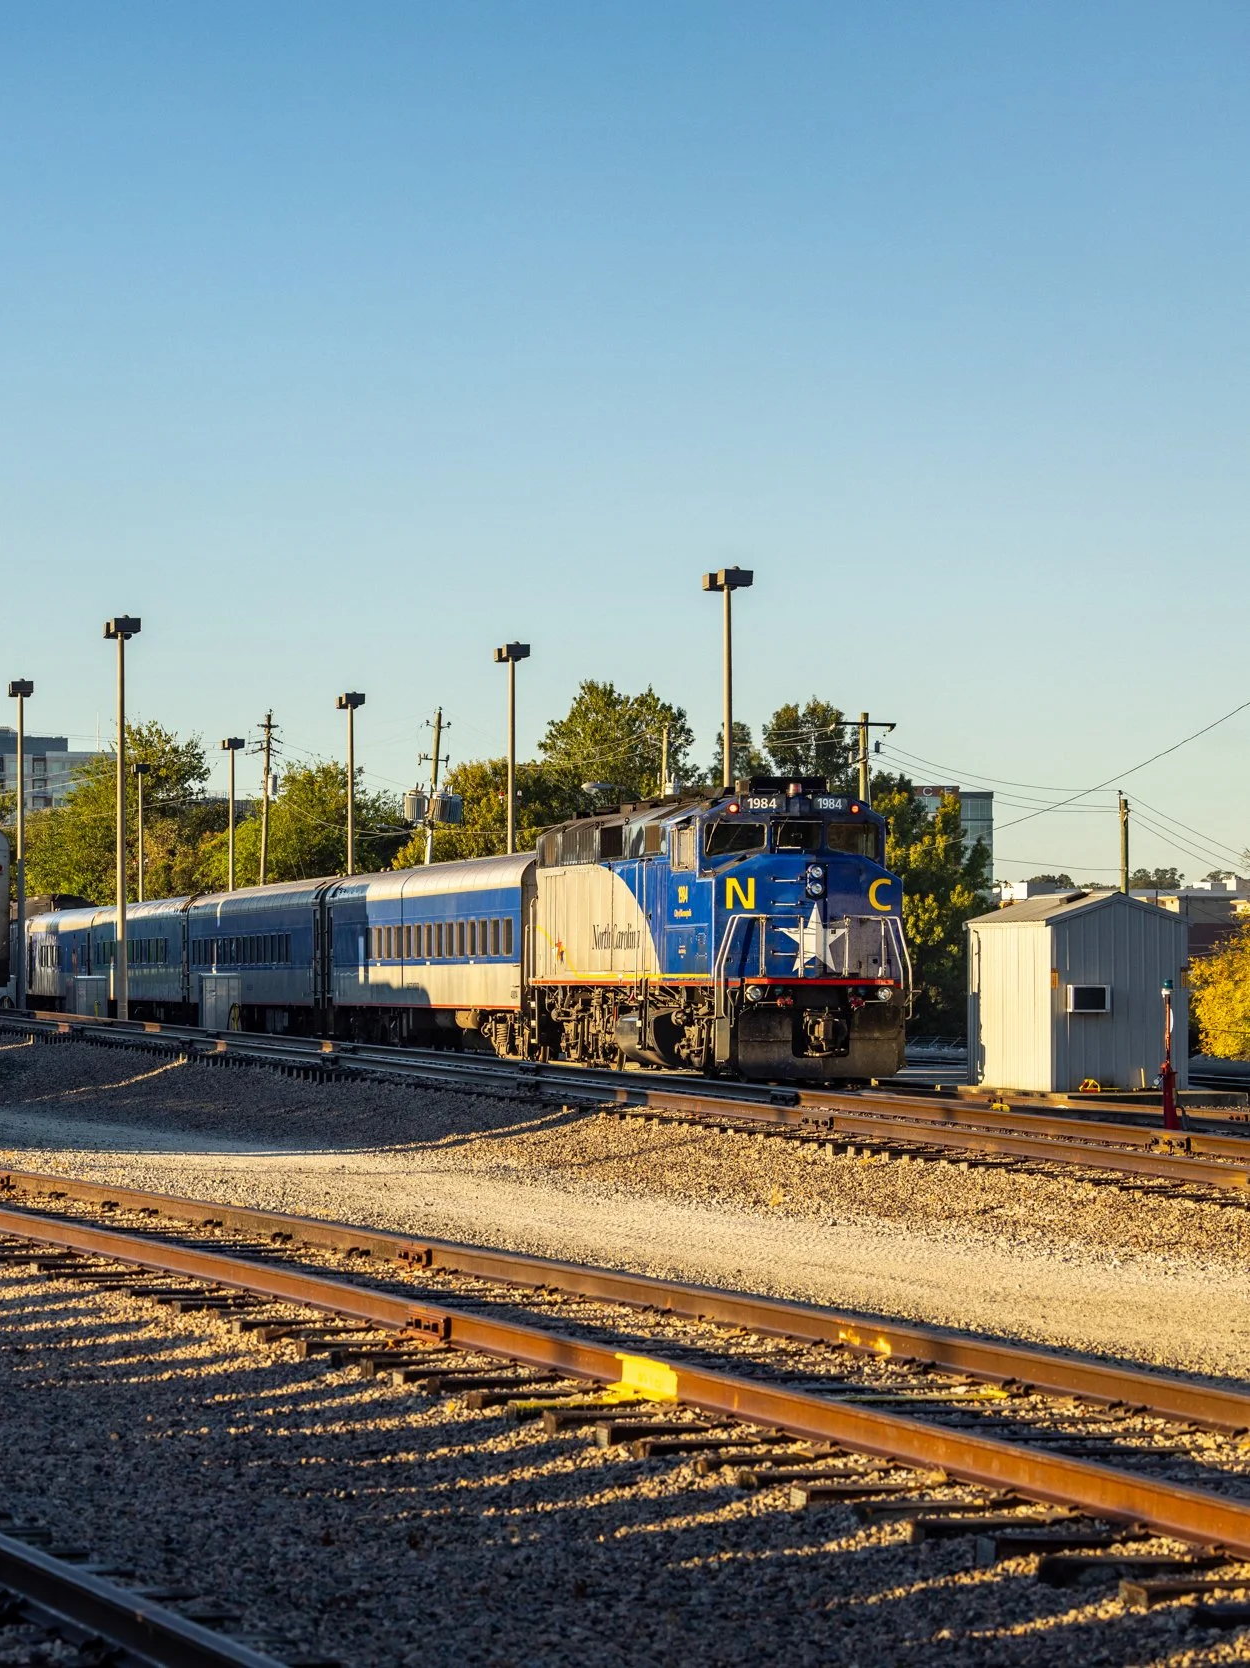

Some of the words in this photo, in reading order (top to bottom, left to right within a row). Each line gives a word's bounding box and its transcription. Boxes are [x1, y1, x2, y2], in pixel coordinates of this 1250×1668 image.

[748, 797, 777, 810] 1984
[817, 798, 843, 810] 1984
[725, 877, 755, 909] N
[868, 878, 892, 911] C
[591, 923, 612, 951] North
